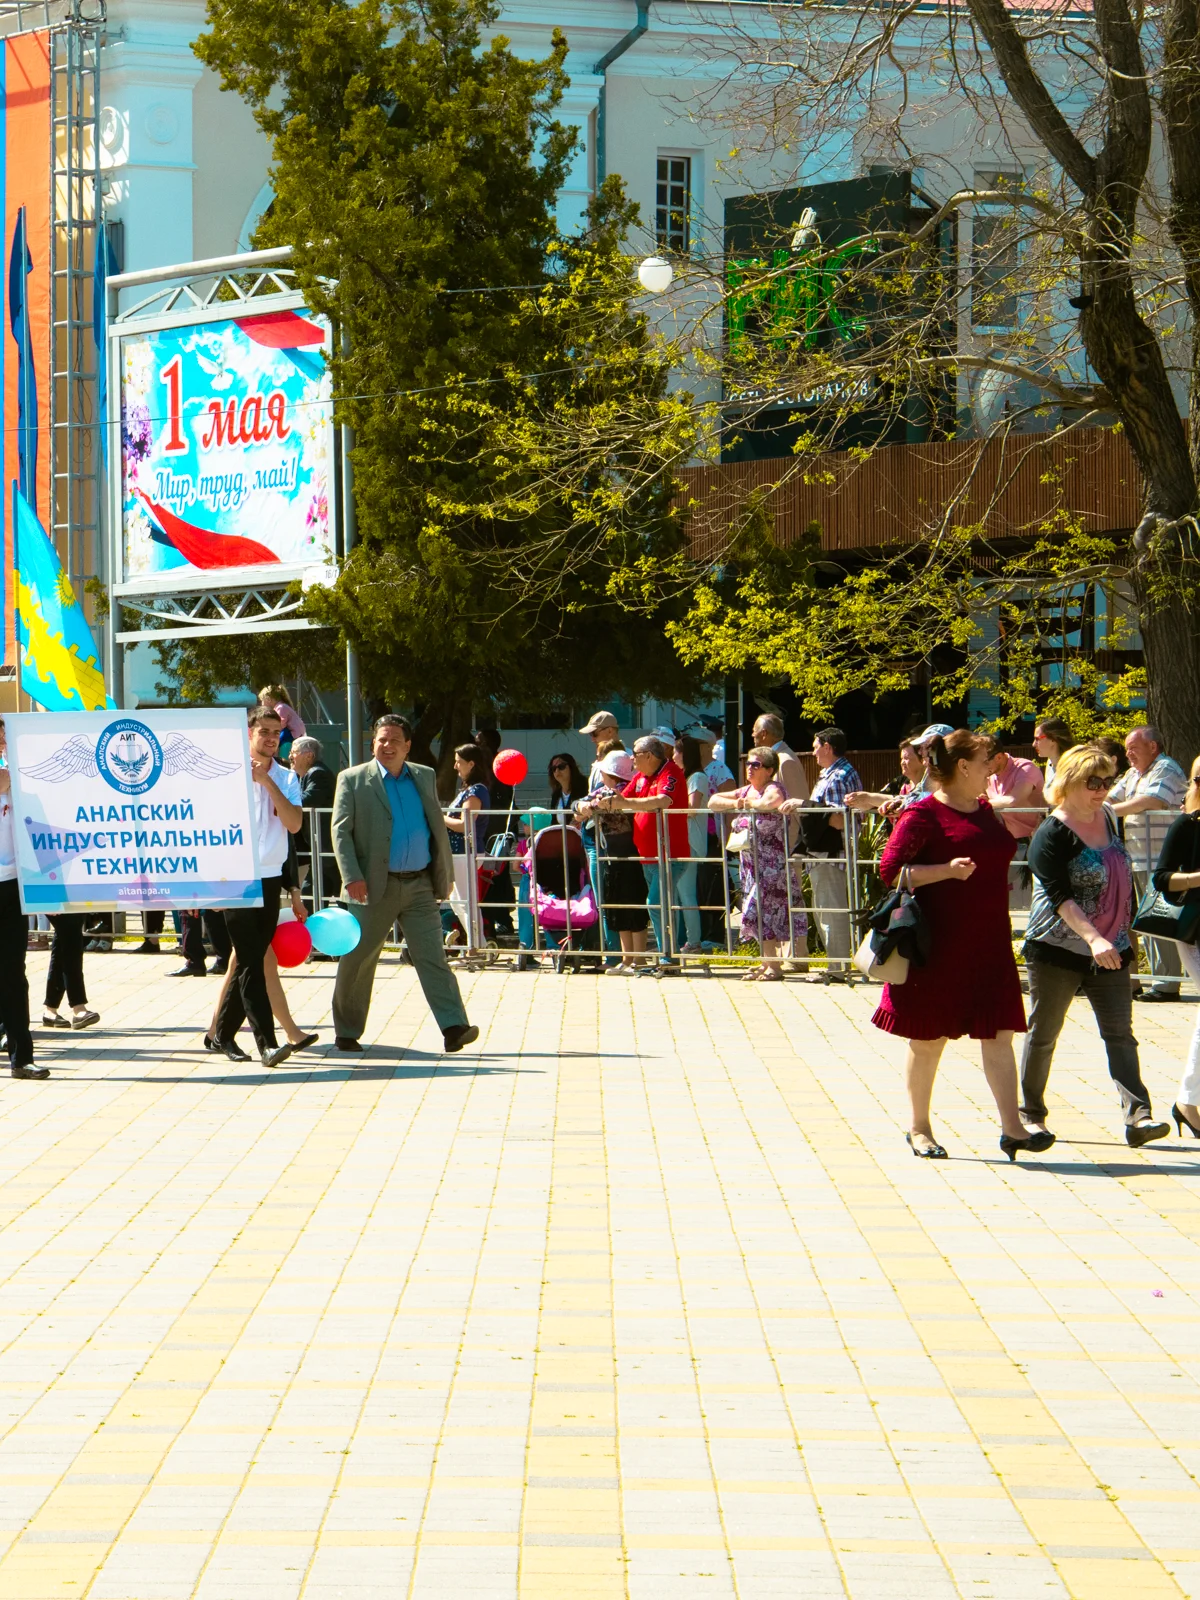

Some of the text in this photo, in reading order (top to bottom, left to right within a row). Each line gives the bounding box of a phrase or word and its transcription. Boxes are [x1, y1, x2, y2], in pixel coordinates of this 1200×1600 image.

[162, 359, 291, 451] 1 мая
[153, 457, 296, 512] Мир, труд, май!
[119, 733, 137, 742] АИТ
[75, 799, 195, 823] АНАПСКИЙ
[32, 824, 244, 853] ИНДУСТРИАЛЬНЫЙ
[82, 856, 199, 875] ТЕХНИКУМ
[118, 886, 171, 897] aitanapa.ru
